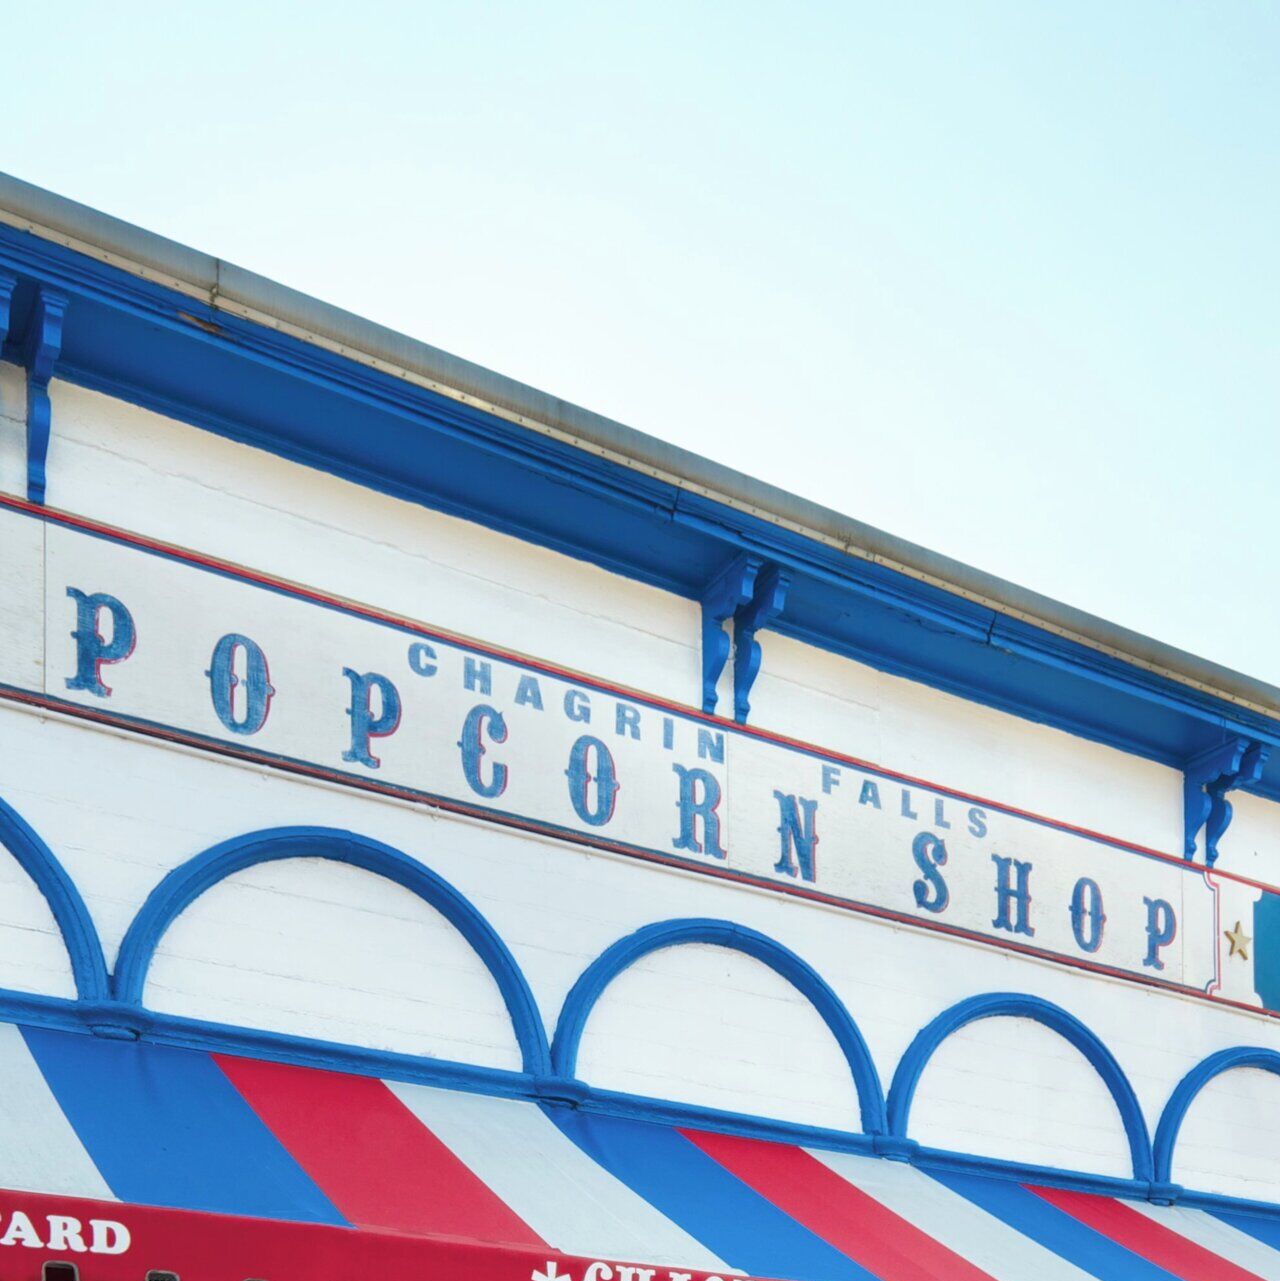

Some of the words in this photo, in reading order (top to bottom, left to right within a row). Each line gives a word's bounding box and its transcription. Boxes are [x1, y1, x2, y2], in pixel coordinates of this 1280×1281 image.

[64, 585, 820, 883] POPCORN
[912, 832, 1178, 972] SHOP
[406, 641, 726, 764] CHAGRIN
[820, 763, 989, 839] FALLS
